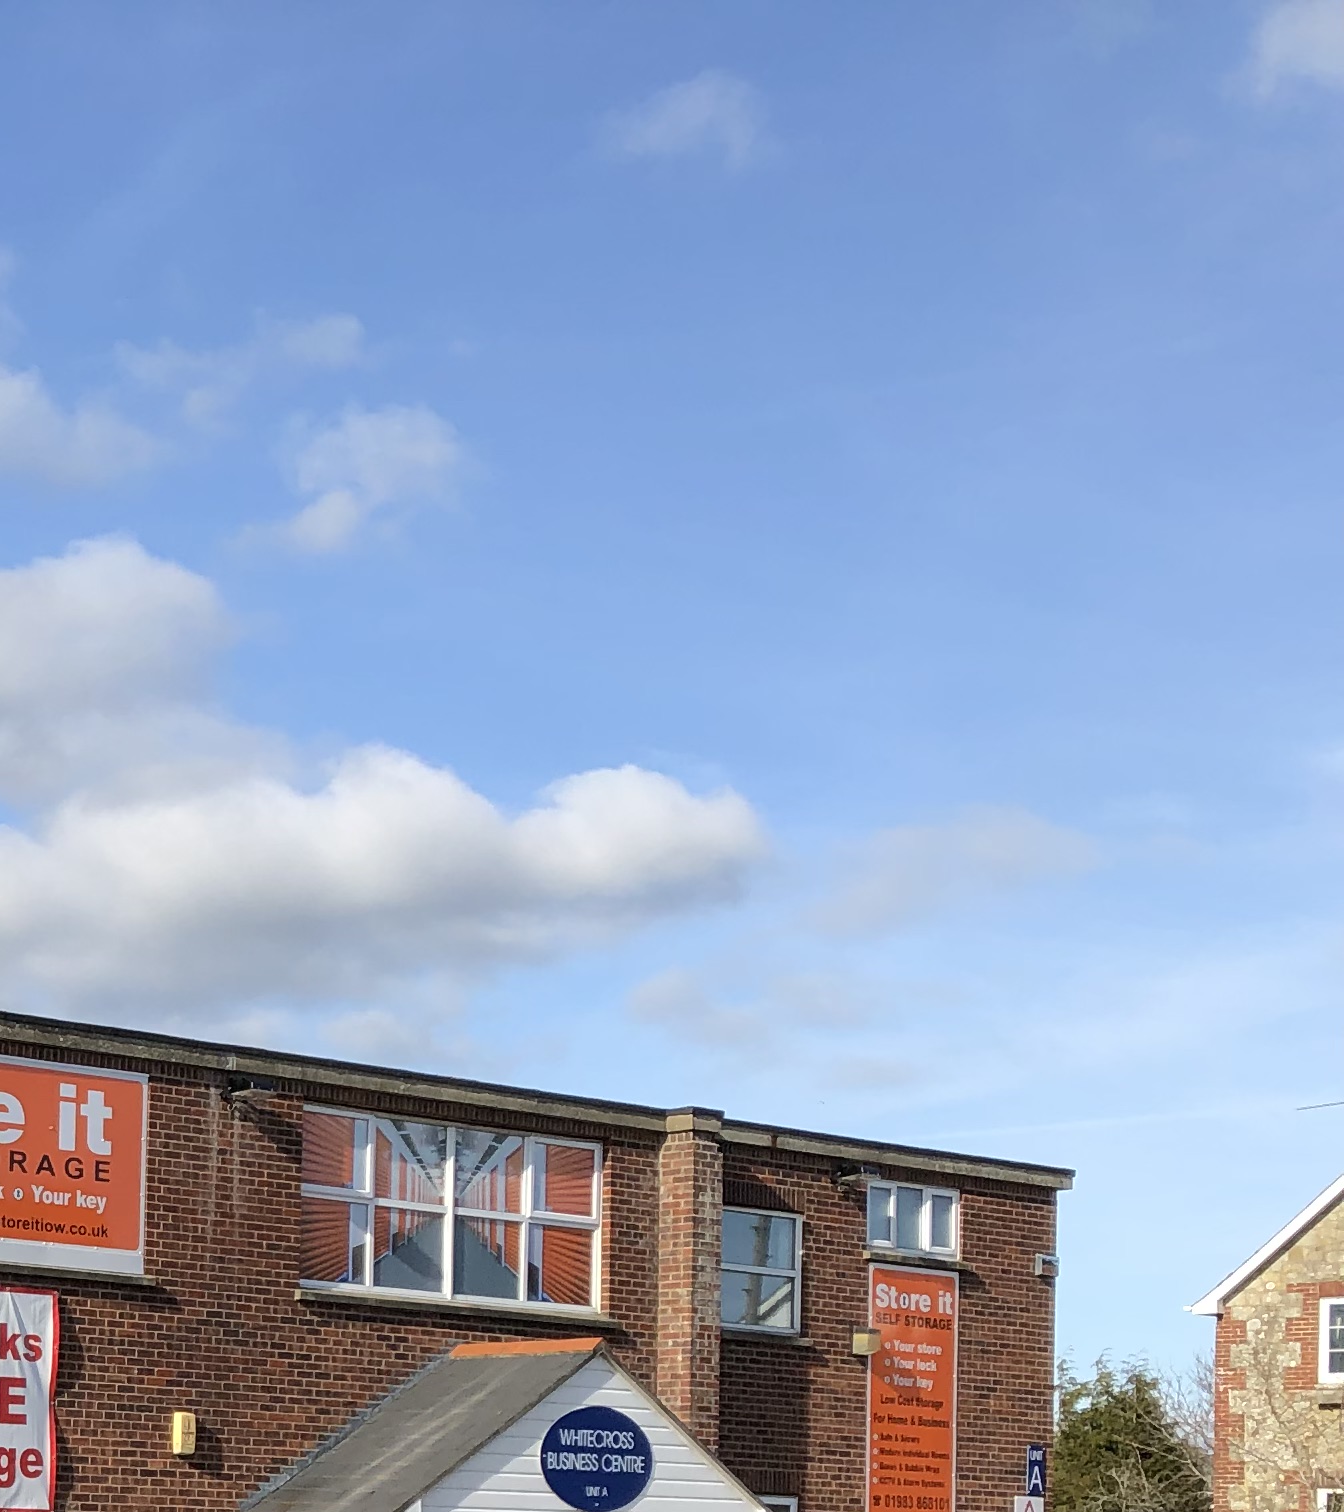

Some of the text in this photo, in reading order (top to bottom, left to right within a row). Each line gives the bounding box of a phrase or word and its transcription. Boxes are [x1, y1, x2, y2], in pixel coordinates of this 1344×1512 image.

[58, 1083, 112, 1156] it
[31, 1185, 72, 1208] Your
[76, 1189, 107, 1214] key
[875, 1283, 953, 1315] Store it
[875, 1312, 953, 1331] SELF STORAGE
[893, 1340, 915, 1353] Your
[559, 1428, 635, 1450] WHITECROSS
[547, 1452, 645, 1473] BUSINESS CENTRE
[1029, 1465, 1043, 1492] A
[601, 1486, 609, 1497] A
[884, 1494, 914, 1509] 01983
